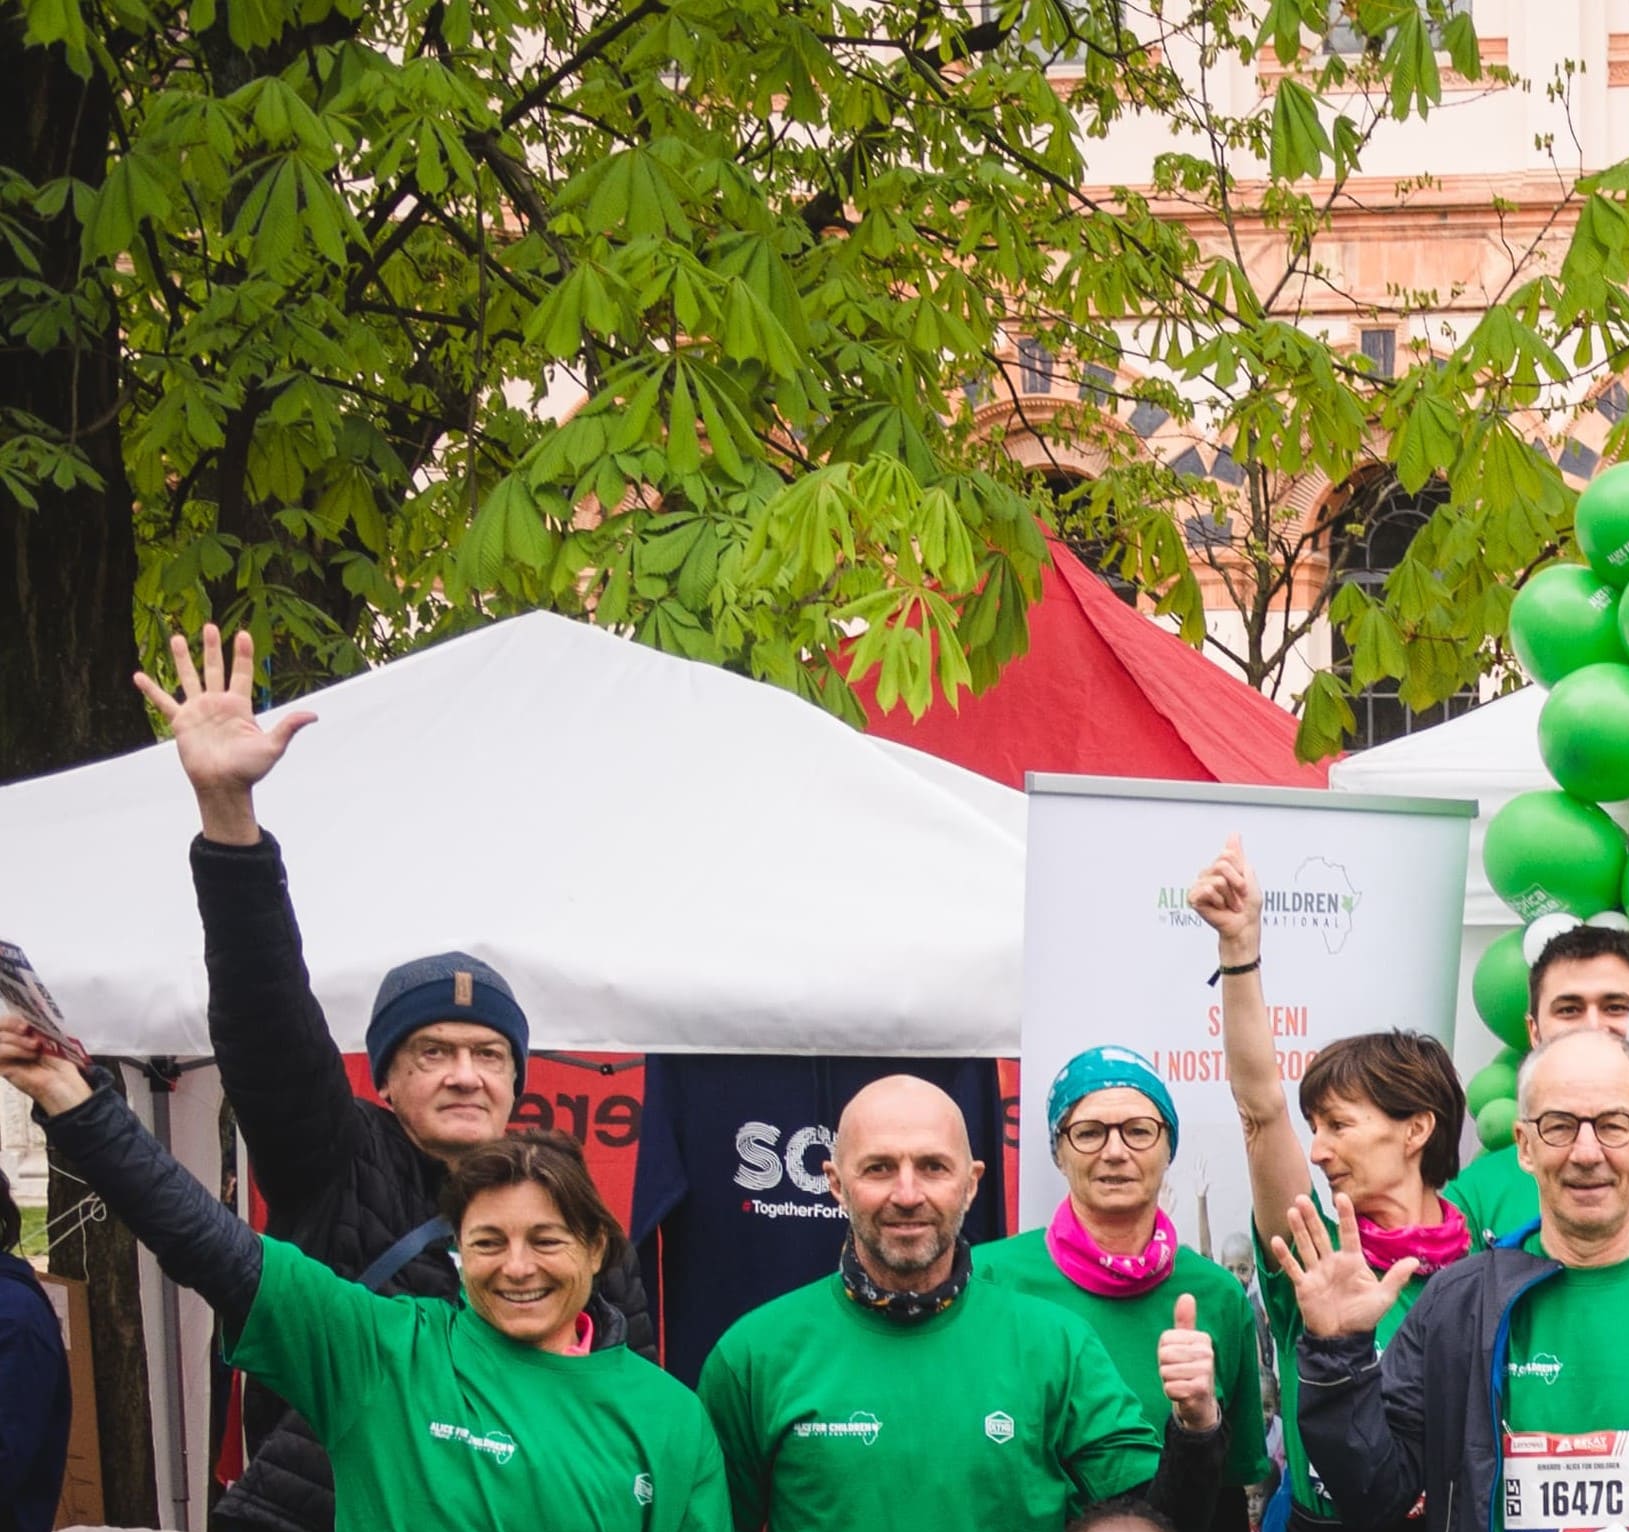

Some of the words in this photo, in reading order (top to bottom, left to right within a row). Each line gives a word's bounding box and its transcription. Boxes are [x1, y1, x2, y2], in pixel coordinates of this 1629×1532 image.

[1157, 887, 1193, 909] ALI
[1264, 890, 1339, 914] HILDREN
[1207, 1005, 1308, 1038] SENI
[1167, 1050, 1232, 1082] NOST
[733, 1120, 837, 1196] SO
[1539, 1479, 1624, 1518] 1647C
